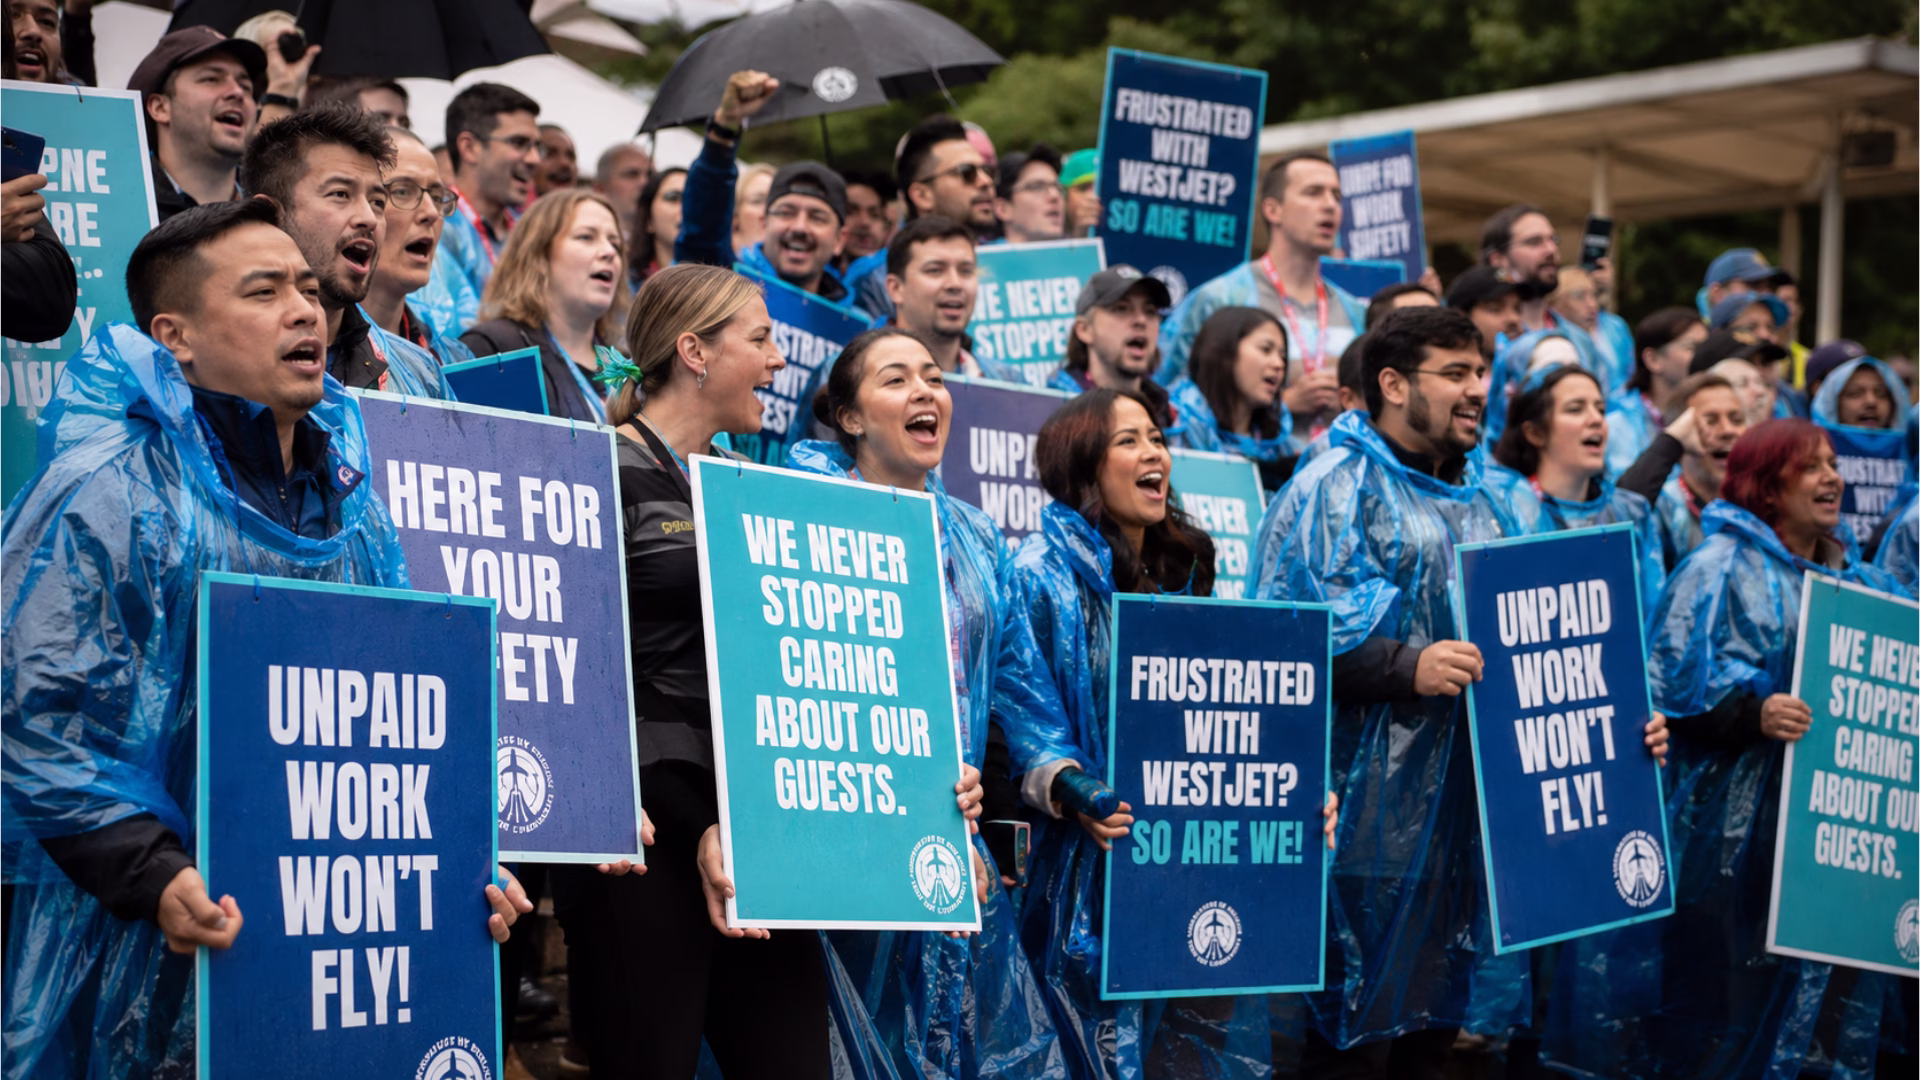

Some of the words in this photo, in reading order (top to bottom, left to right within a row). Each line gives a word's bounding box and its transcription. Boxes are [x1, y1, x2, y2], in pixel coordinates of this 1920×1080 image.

[1115, 87, 1253, 140] FRUSTRATED
[1151, 127, 1210, 168] WITH
[1118, 158, 1236, 206] WESTJET?
[1107, 198, 1140, 233] SO
[1143, 203, 1189, 240] ARE
[1194, 210, 1237, 247] WE!
[971, 426, 1041, 480] UNPA
[386, 459, 506, 539] HERE
[519, 475, 602, 550] FOR
[742, 513, 800, 570] WE
[806, 523, 909, 584] NEVER
[440, 545, 563, 623] YOUR
[760, 574, 904, 639] STOPPED
[1497, 579, 1612, 647] UNPAID
[496, 631, 578, 705] ETY
[779, 635, 899, 697] CARING
[1131, 655, 1315, 706] FRUSTRATED
[1512, 643, 1609, 709] WORK
[1829, 623, 1867, 673] WE
[1869, 634, 1919, 688] NEVE
[268, 664, 447, 750] UNPAID
[756, 694, 859, 752] ABOUT
[870, 704, 932, 757] OUR
[1184, 709, 1260, 755] WITH
[1514, 705, 1616, 775] WON'T
[1834, 725, 1914, 783] CARING
[285, 760, 433, 841] WORK
[774, 757, 907, 815] GUESTS.
[1142, 760, 1299, 807] WESTJET?
[1541, 771, 1608, 835] FLY!
[1808, 769, 1883, 824] ABOUT
[1131, 819, 1172, 865] SO
[1181, 820, 1239, 864] ARE
[1250, 821, 1303, 864] WE!
[1814, 821, 1902, 879] GUESTS.
[278, 855, 439, 936] WON'T
[311, 946, 412, 1031] FLY!
